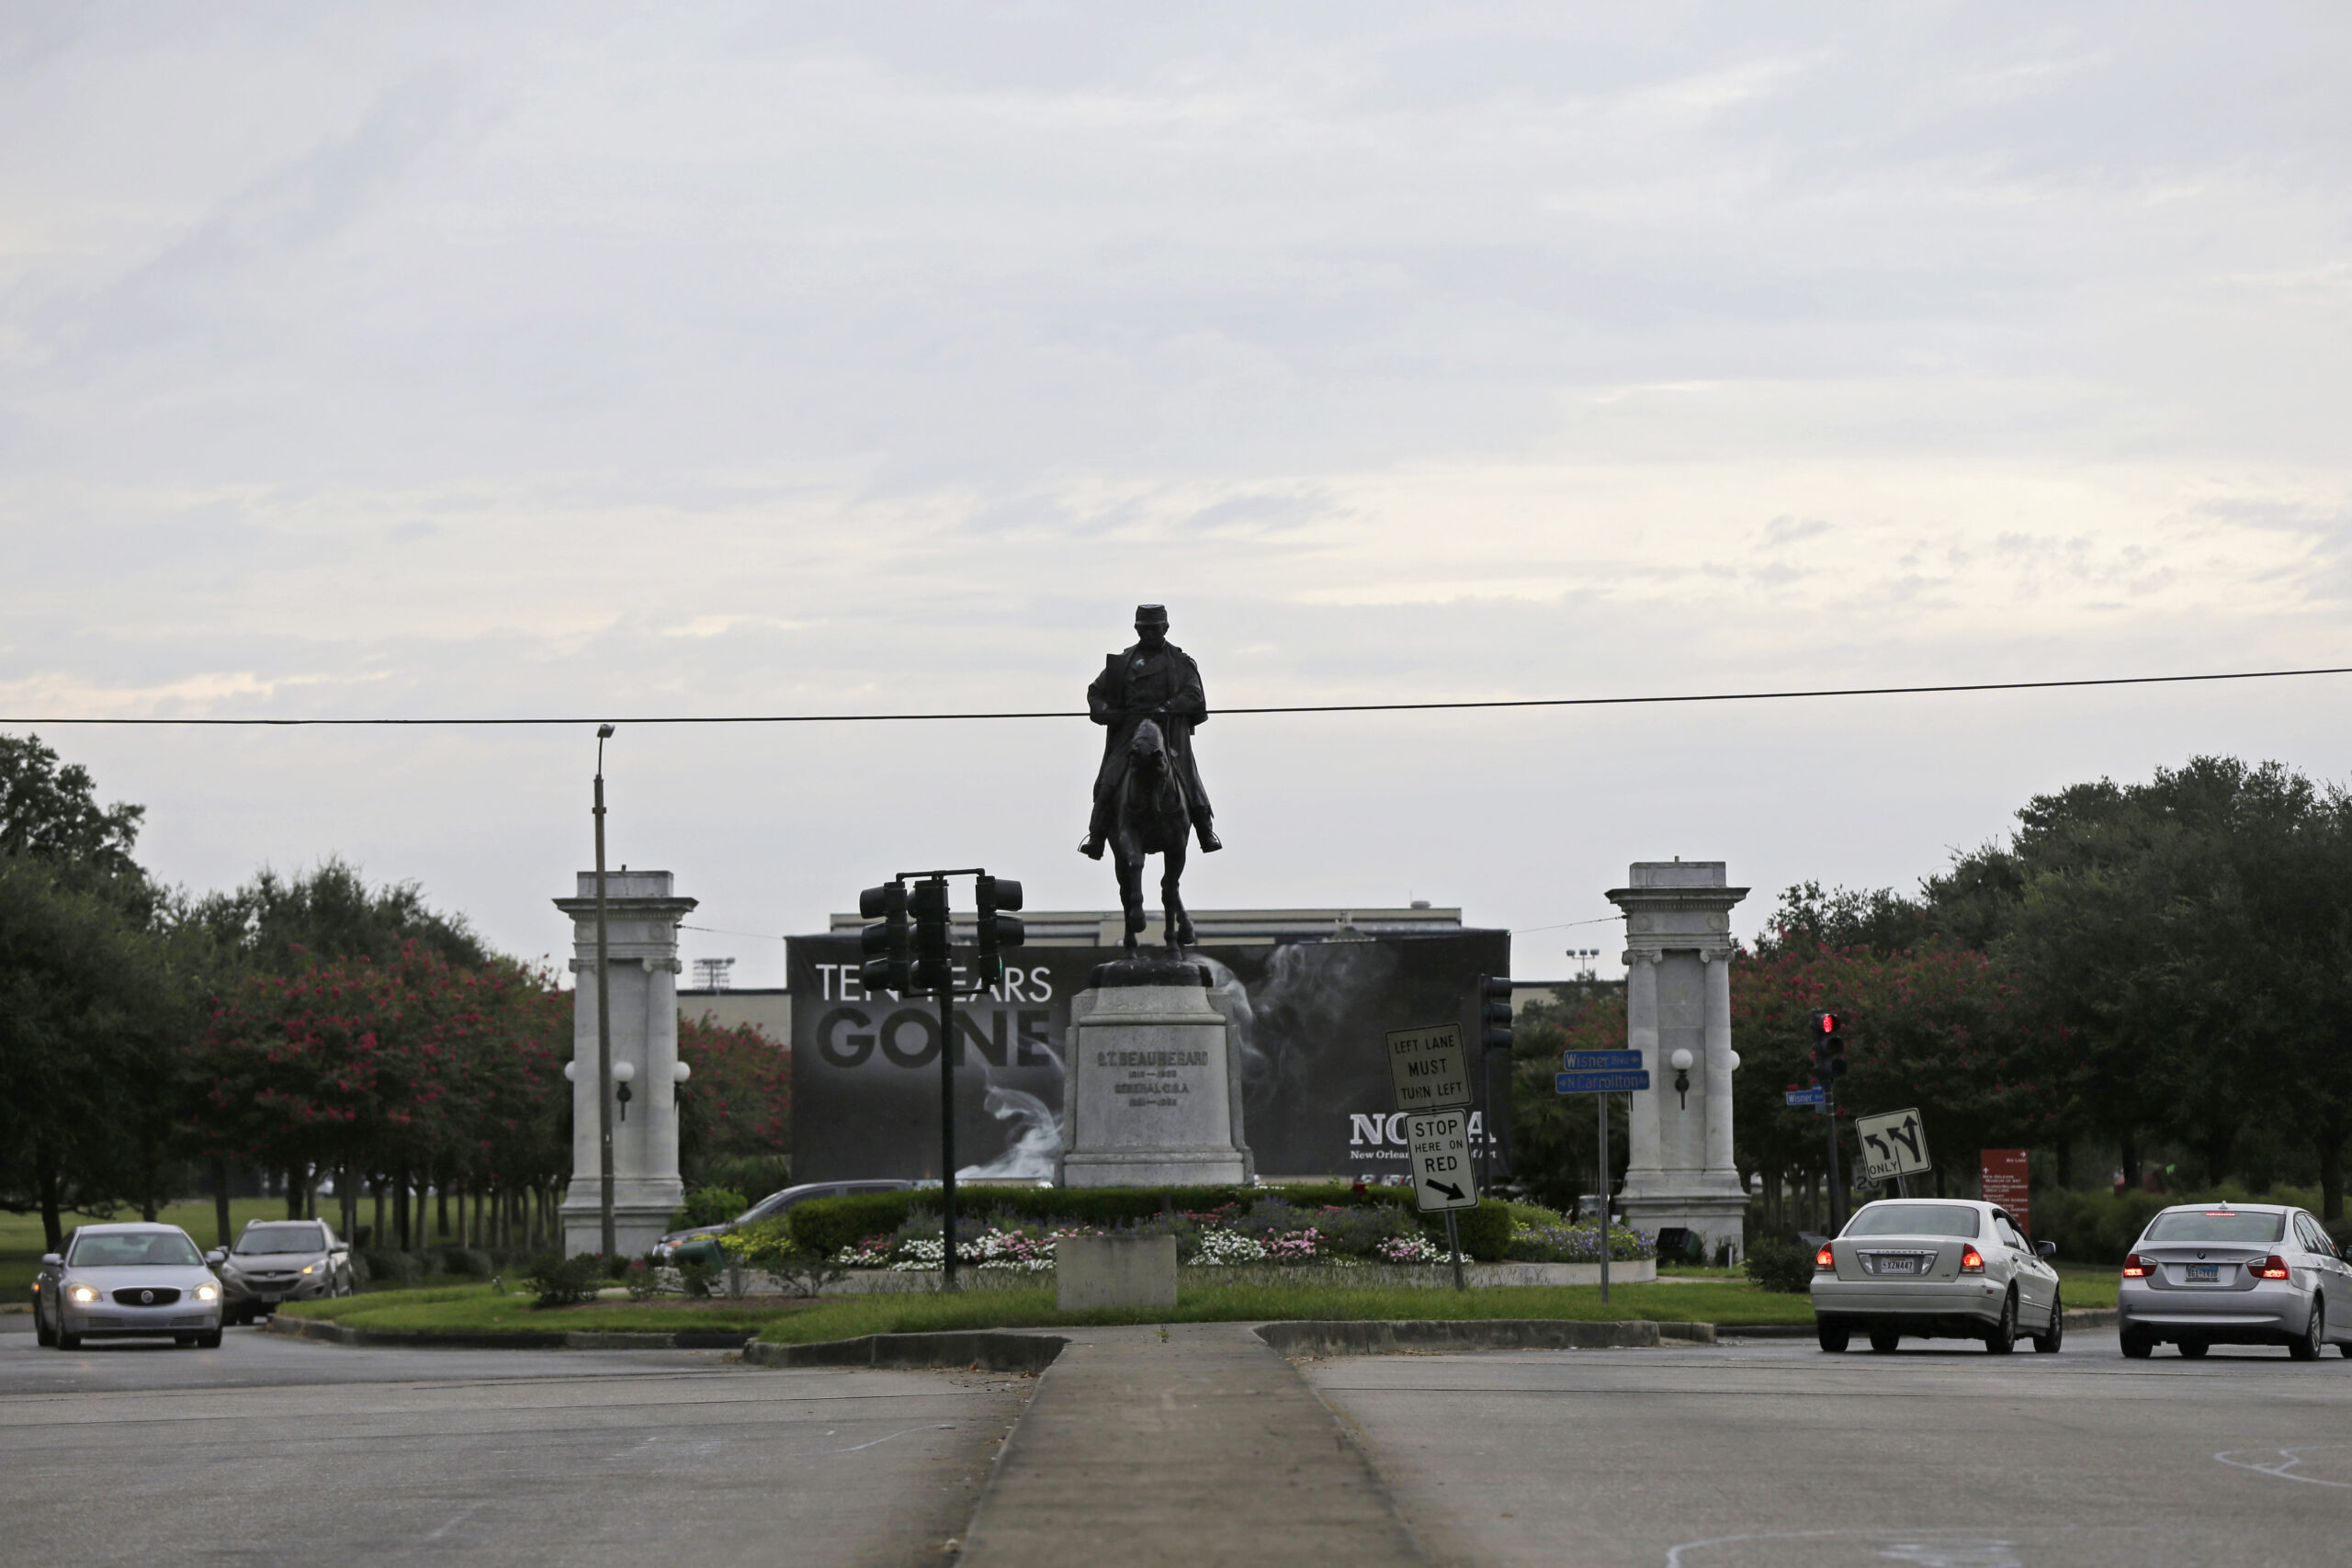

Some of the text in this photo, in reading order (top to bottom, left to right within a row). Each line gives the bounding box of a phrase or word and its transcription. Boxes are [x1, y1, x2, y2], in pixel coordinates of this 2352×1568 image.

[925, 966, 1053, 1002] EARS
[816, 1007, 1051, 1069] GONE
[1394, 1034, 1455, 1055] LEFT LANE
[1408, 1058, 1448, 1077] MUST
[1566, 1054, 1610, 1068] Wisner
[1577, 1074, 1638, 1089] Carrollton
[1401, 1081, 1463, 1100] TURN LEFT
[1788, 1094, 1812, 1103] Wisner
[1350, 1111, 1497, 1145] NOA
[1415, 1119, 1458, 1138] STOP
[1351, 1150, 1374, 1159] New
[1376, 1149, 1408, 1159] Orlea
[1415, 1139, 1464, 1154] HERE ON
[1425, 1156, 1458, 1173] RED
[1869, 1160, 1898, 1176] ONLY
[1887, 1261, 1913, 1270] XZN447
